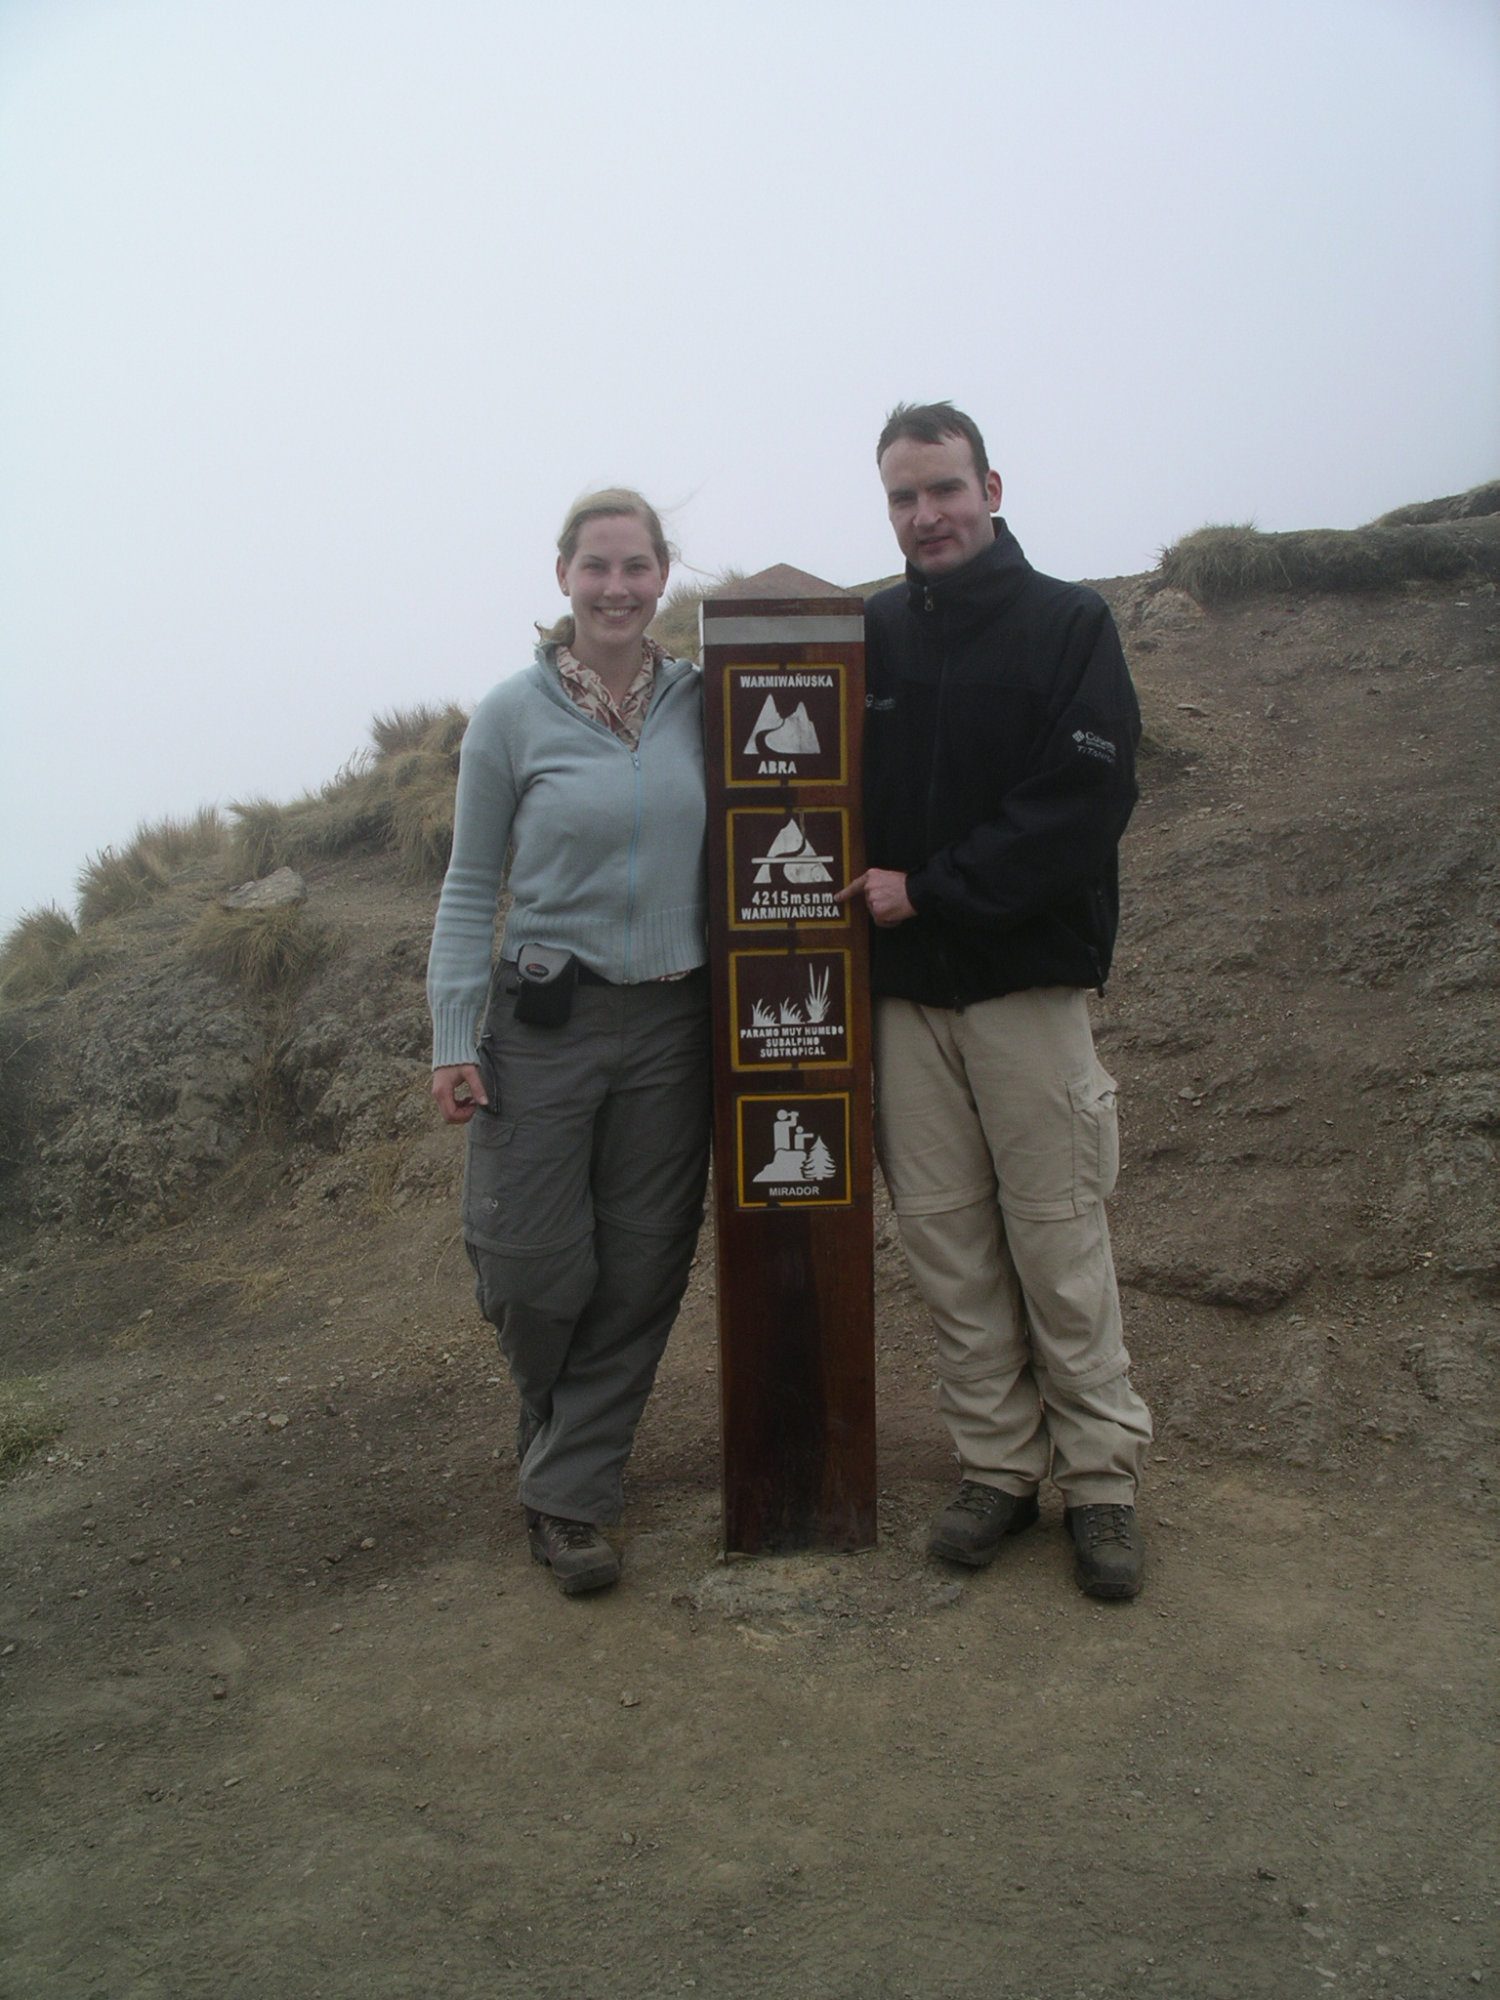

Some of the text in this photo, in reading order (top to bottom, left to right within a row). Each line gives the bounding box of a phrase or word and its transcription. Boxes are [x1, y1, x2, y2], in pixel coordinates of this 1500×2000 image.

[740, 674, 834, 688] WARMIWAÑUSKA
[758, 761, 797, 774] ABRA
[741, 904, 840, 920] WARMIWAÑUSKA
[740, 1026, 844, 1039] PARAMO MUY HUMEDO
[766, 1037, 820, 1047] SUBALPINO
[760, 1047, 826, 1058] SUBTROPICAL
[769, 1186, 820, 1196] MIRADOR
